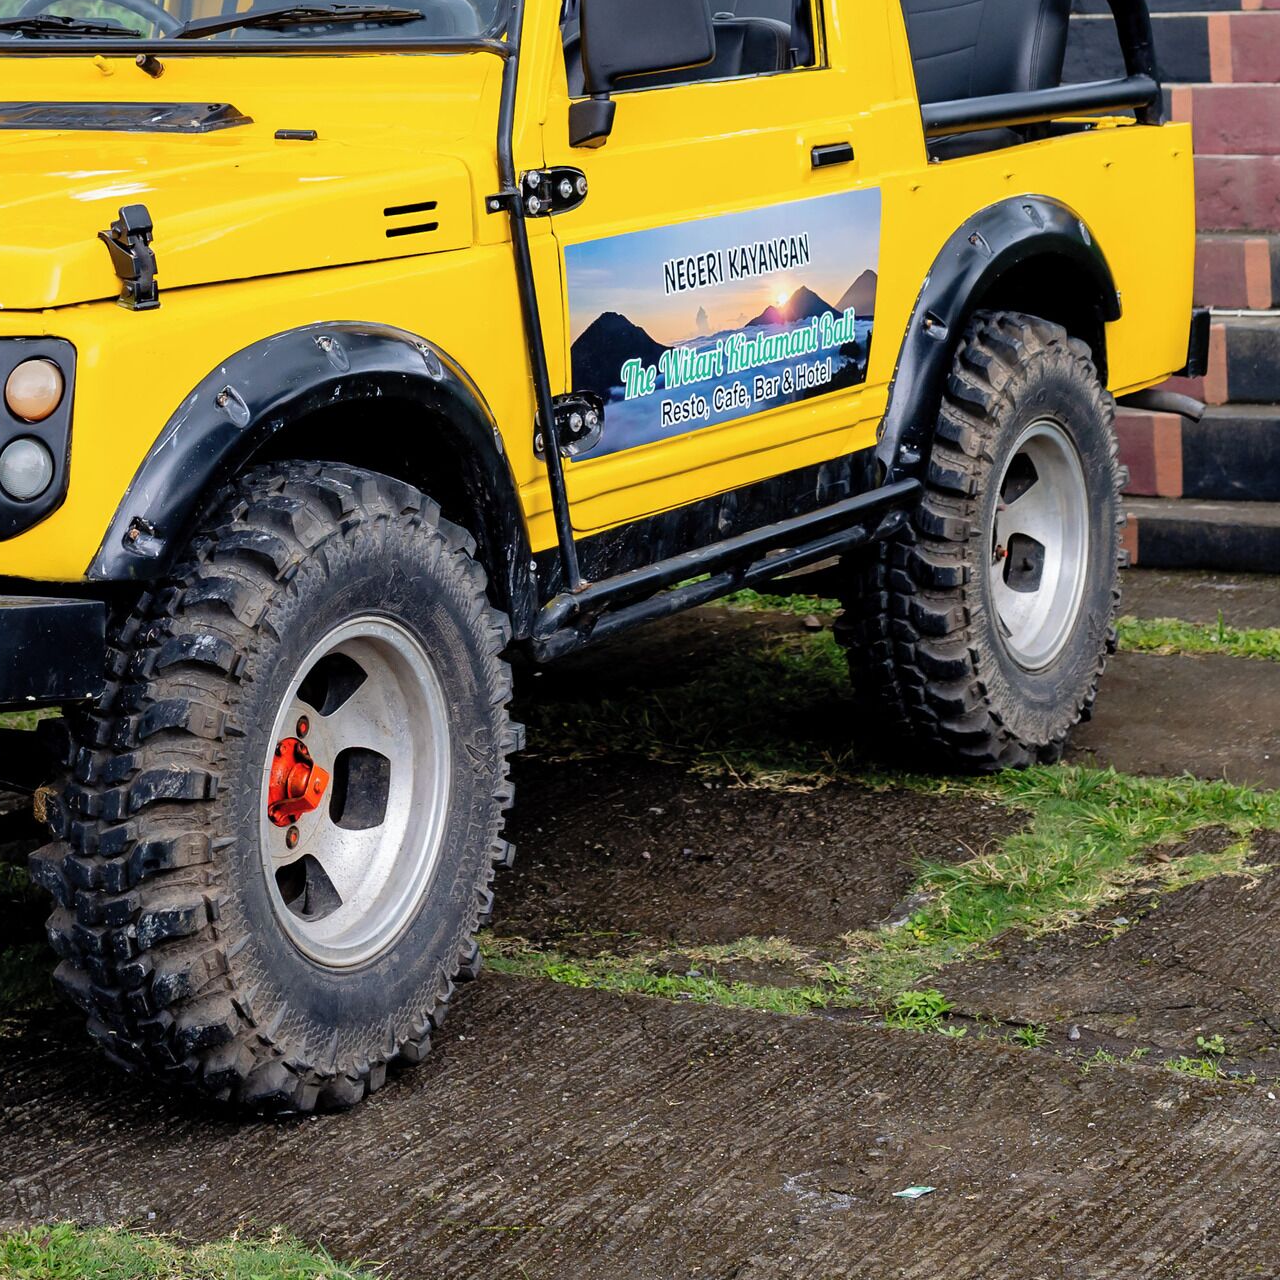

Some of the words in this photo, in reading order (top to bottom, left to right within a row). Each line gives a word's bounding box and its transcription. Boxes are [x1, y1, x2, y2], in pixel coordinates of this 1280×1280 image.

[663, 251, 724, 294] NEGERI
[728, 232, 810, 279] KAYANGAN
[621, 358, 656, 400] The
[659, 339, 723, 389] Witari
[725, 316, 818, 373] Kintamani
[820, 307, 856, 350] Bali
[662, 394, 710, 426] Resto,
[714, 381, 751, 410] Cafe,
[755, 375, 780, 401] Bar
[783, 369, 794, 392] &
[796, 358, 832, 389] Hotel
